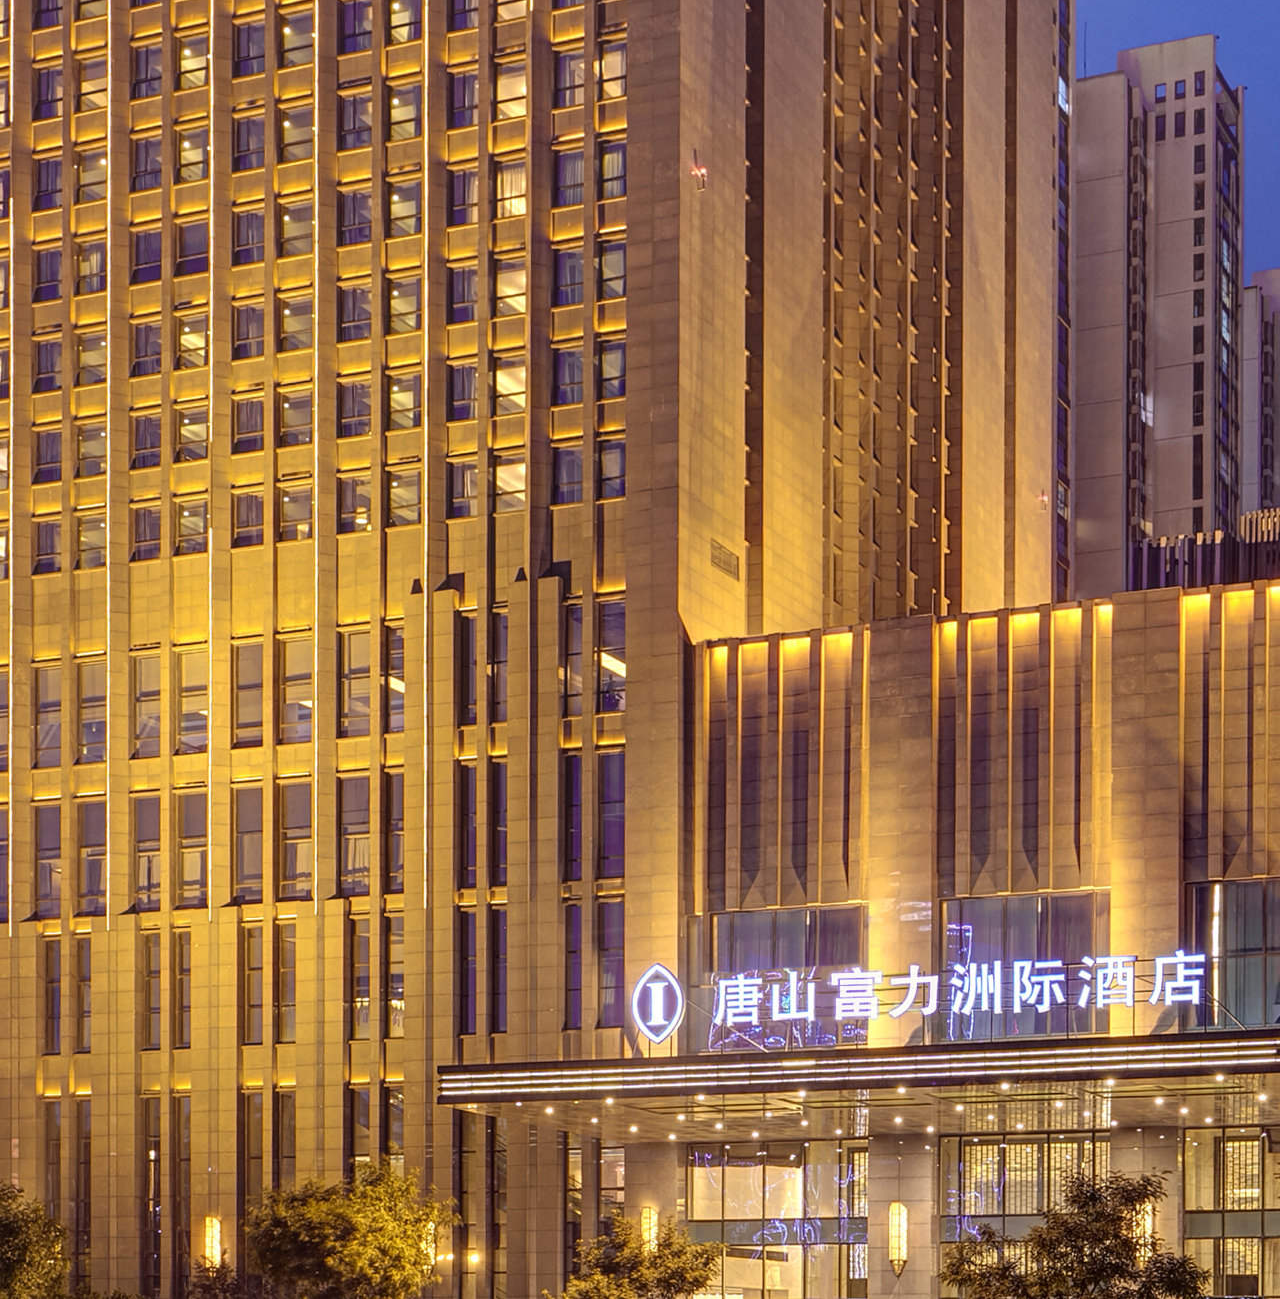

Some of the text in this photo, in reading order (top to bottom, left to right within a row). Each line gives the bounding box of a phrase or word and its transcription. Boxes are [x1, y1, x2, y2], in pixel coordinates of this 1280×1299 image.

[712, 949, 1206, 1027] 唐山富力洲际酒店
